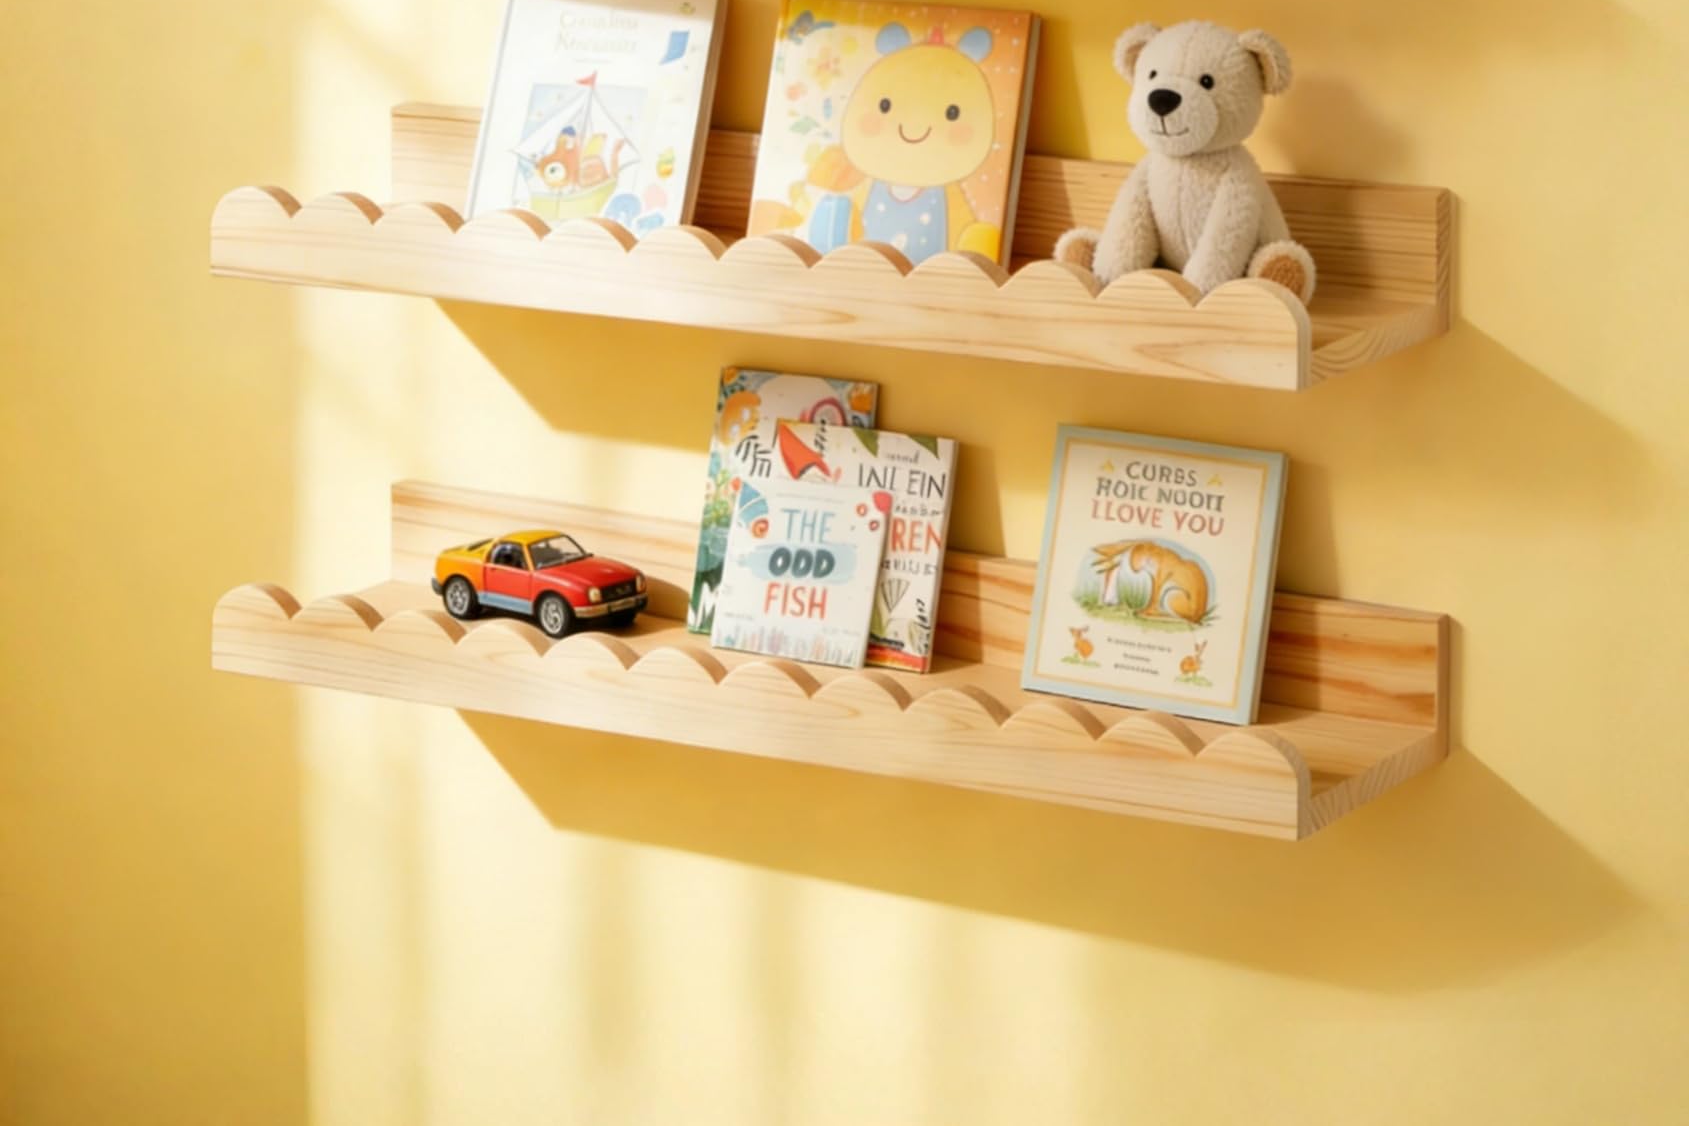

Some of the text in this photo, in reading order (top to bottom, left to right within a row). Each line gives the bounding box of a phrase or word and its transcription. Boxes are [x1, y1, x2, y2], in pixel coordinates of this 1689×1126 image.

[781, 507, 837, 544] THE
[1174, 510, 1225, 536] YOU
[768, 546, 837, 579] ODD
[764, 583, 828, 619] FISH
